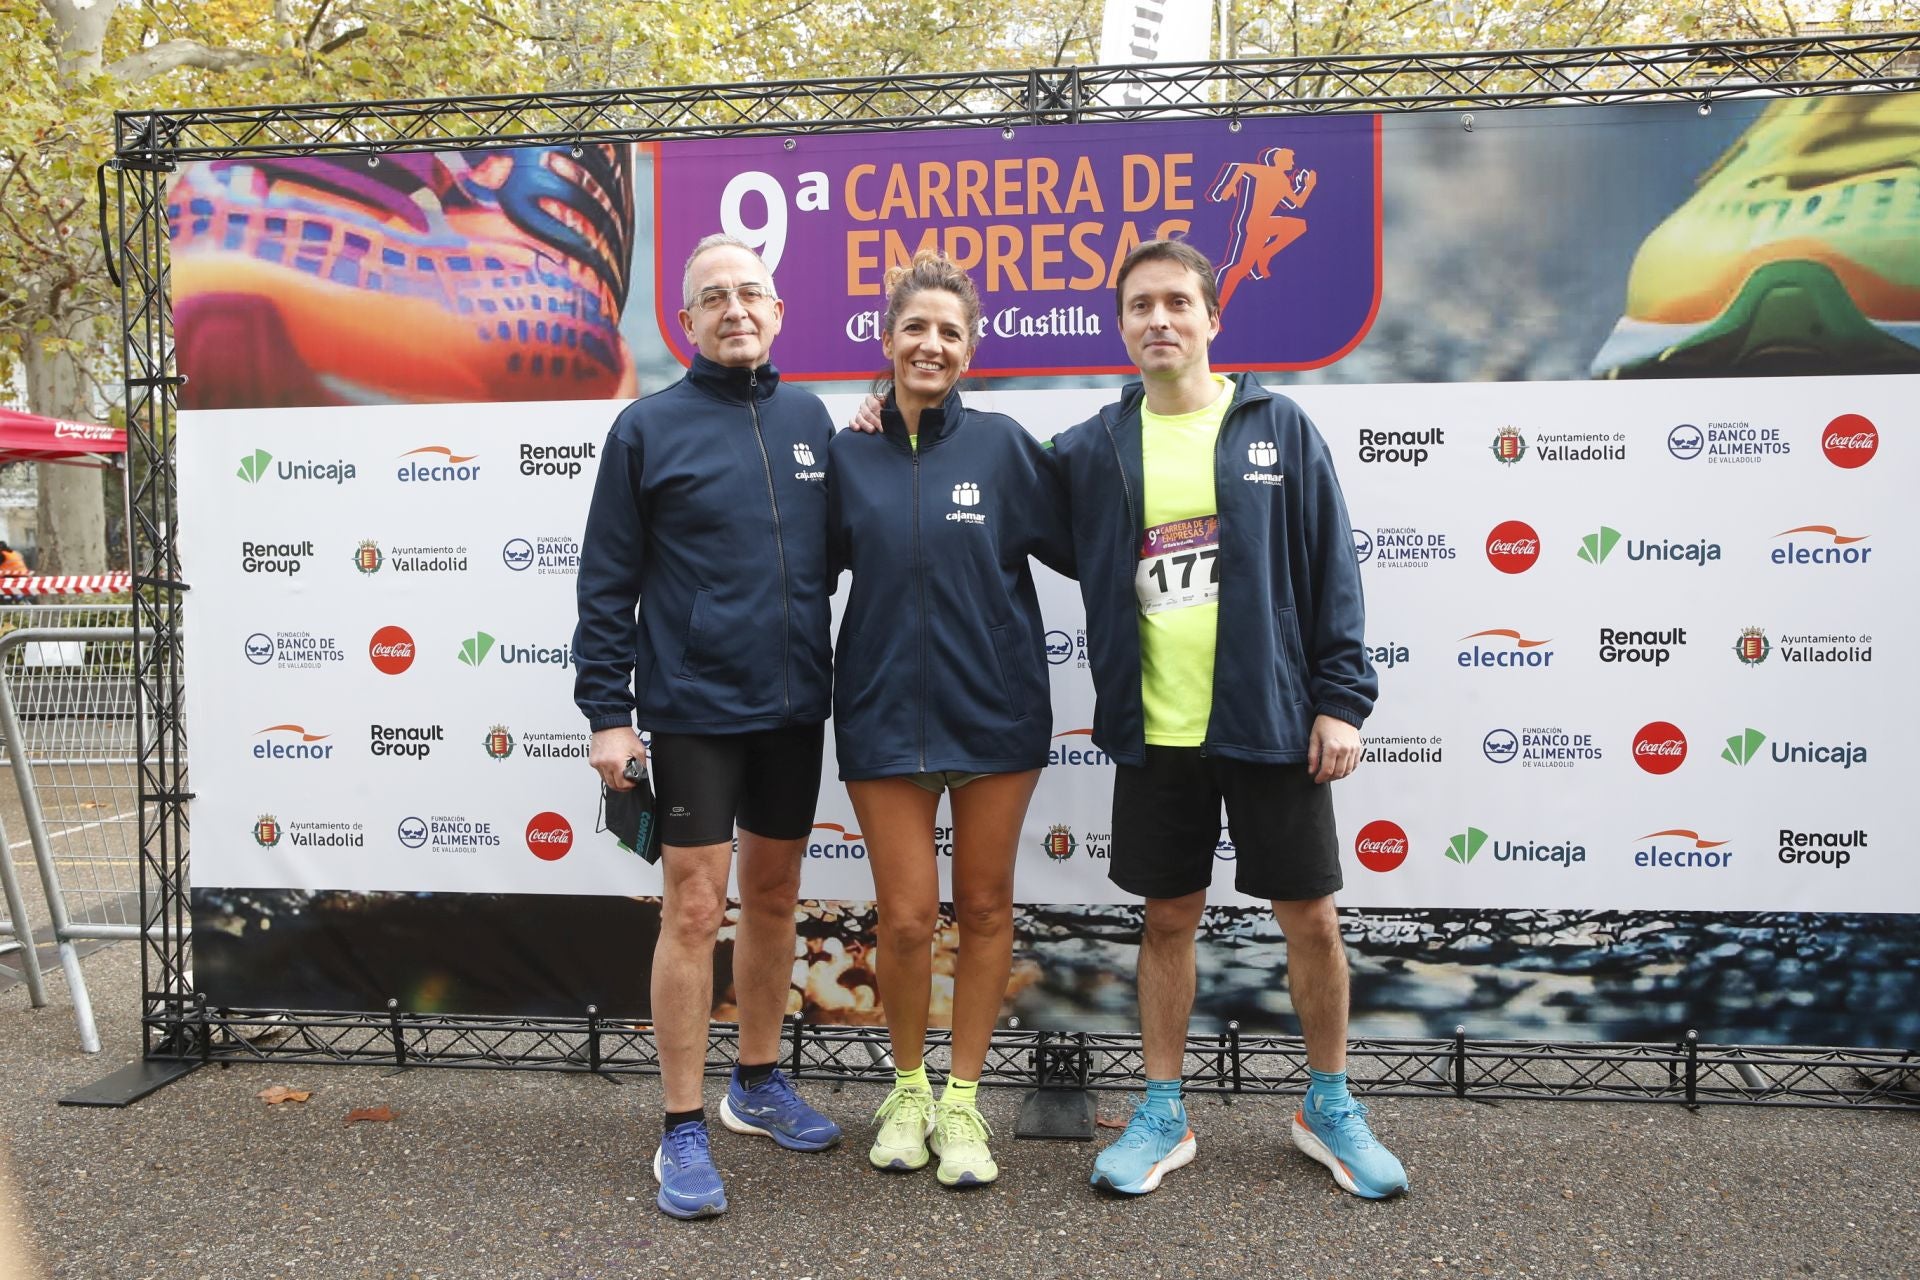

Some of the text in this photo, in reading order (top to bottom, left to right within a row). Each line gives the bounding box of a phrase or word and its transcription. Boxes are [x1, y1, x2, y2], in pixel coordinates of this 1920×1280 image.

[844, 155, 1104, 221] CARRERA
[1123, 153, 1194, 212] DE
[846, 310, 881, 342] El
[993, 306, 1101, 338] Castilla
[1360, 428, 1444, 446] Renault
[1537, 432, 1626, 444] Ayuntamiento de
[1708, 429, 1779, 441] BANCO DE
[1825, 433, 1876, 449] Coca-Cola
[520, 442, 596, 459] Renault
[1537, 445, 1625, 461] Valladolid
[1708, 442, 1790, 455] ALIMENTOS
[1359, 446, 1428, 467] Group
[278, 459, 356, 485] Unicaja
[397, 462, 480, 482] elecnor
[520, 460, 581, 479] Group
[1243, 471, 1284, 484] cajamar
[945, 510, 986, 522] cajamar
[1160, 521, 1192, 535] CARRERA
[1162, 527, 1204, 543] EMPRESAS
[1377, 534, 1445, 547] BANCO DE
[1489, 539, 1537, 555] Coca-Cola
[243, 541, 314, 557] Renault
[392, 545, 467, 556] Ayuntamiento de
[537, 543, 578, 554] BANCO
[1377, 548, 1456, 559] ALIMENTOS
[1627, 539, 1721, 567] Unicaja
[1771, 542, 1872, 564] elecnor
[242, 557, 300, 576] Group
[392, 557, 467, 571] Valladolid
[277, 638, 335, 649] BANCO DE
[1600, 628, 1686, 645] Renault
[1781, 634, 1872, 645] Ayuntamiento de
[278, 650, 344, 661] ALIMENTOS
[372, 643, 413, 657] Coca-Cola
[1458, 645, 1554, 667] elecnor
[1599, 645, 1670, 667] Group
[1781, 647, 1872, 662] Valladolid
[371, 725, 444, 740] Renault
[523, 732, 586, 742] Ayuntamiento
[1429, 735, 1442, 744] de
[1522, 735, 1591, 746] BANCO DE
[1635, 740, 1684, 755] Coca-Cola
[253, 739, 333, 759] elecnor
[371, 740, 430, 760] Group
[1523, 748, 1602, 759] ALIMENTOS
[1772, 741, 1867, 769] Unicaja
[290, 821, 363, 831] Ayuntamiento de
[431, 822, 490, 834] BANCO DE
[290, 832, 363, 847] Valladolid
[432, 835, 500, 846] ALIMENTOS
[528, 829, 570, 843] Coca-Cola
[1780, 830, 1868, 847] Renault
[1358, 838, 1405, 853] Coca-Cola
[1494, 840, 1585, 868] Unicaja
[1635, 846, 1732, 867] elecnor
[1778, 846, 1850, 869] Group
